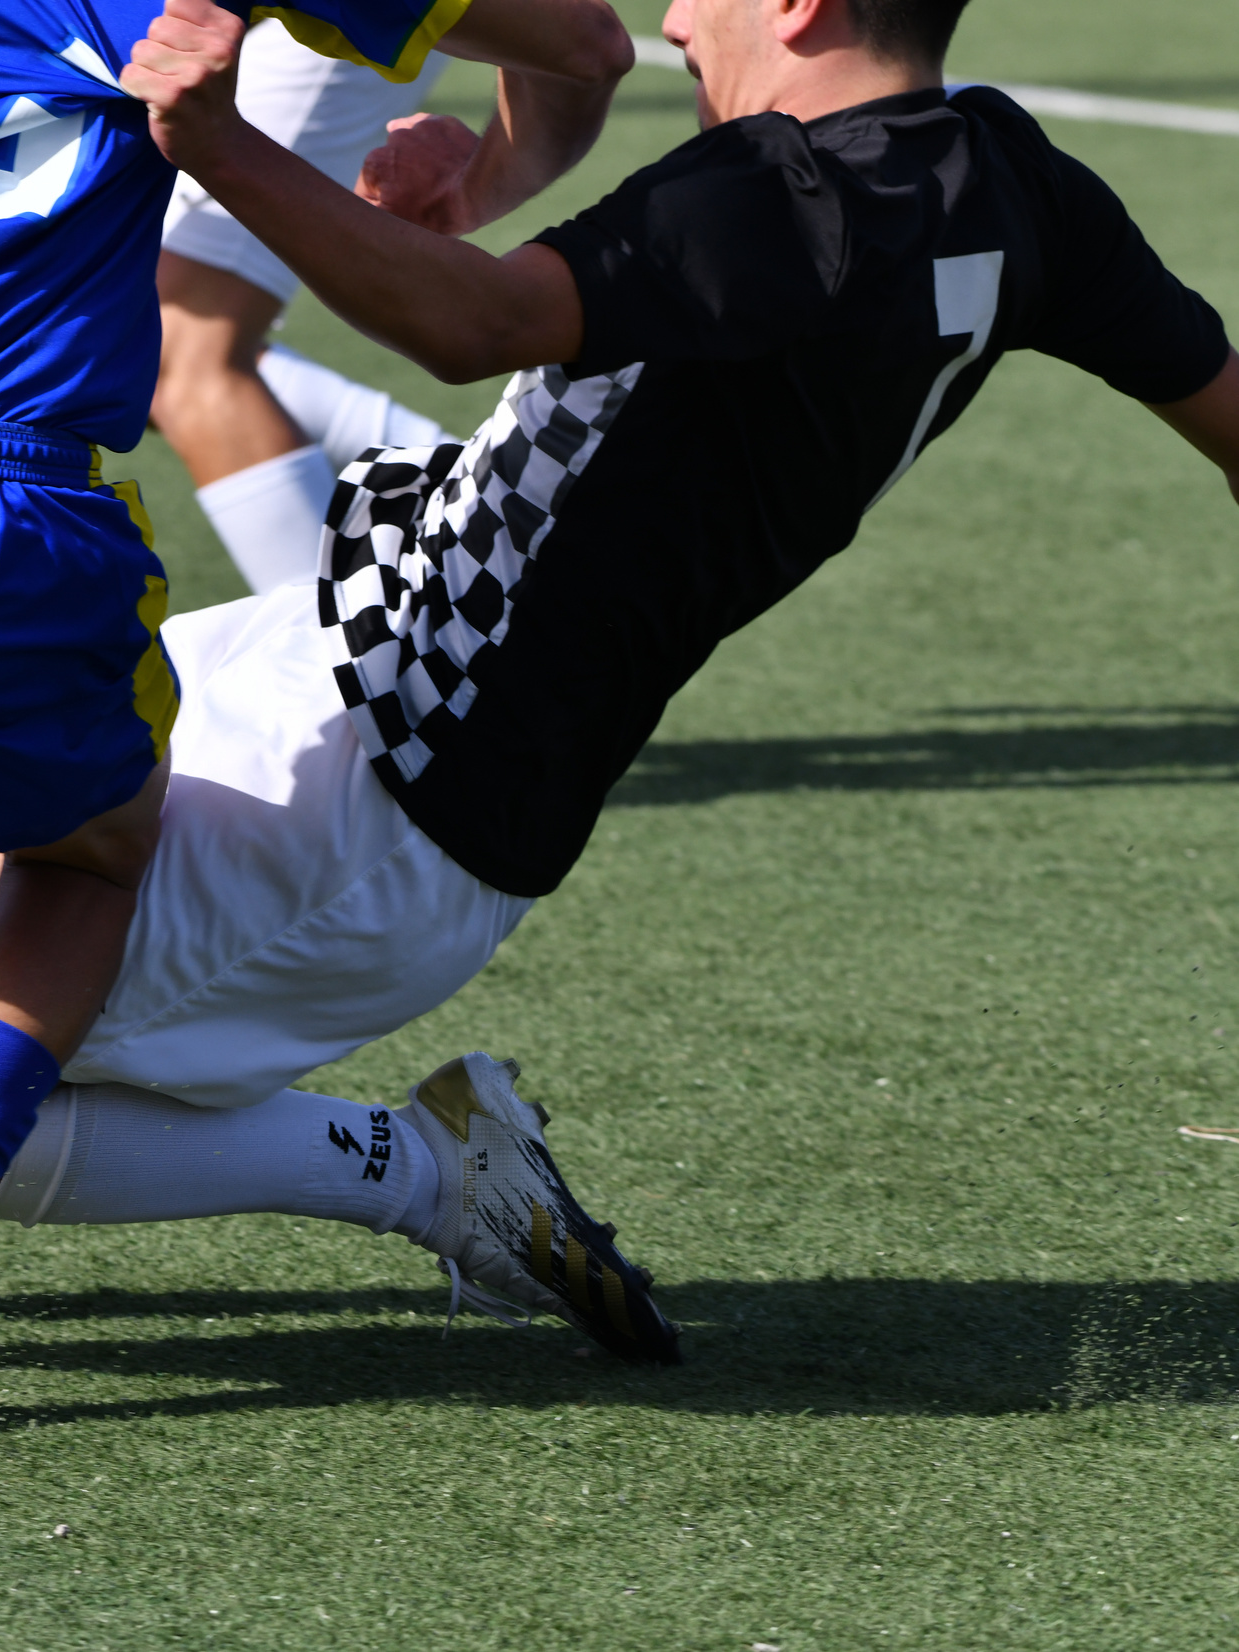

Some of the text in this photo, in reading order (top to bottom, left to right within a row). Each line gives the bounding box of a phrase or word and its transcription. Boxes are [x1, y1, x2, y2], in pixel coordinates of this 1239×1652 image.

[362, 1109, 392, 1183] ZEUS
[477, 1148, 489, 1172] R.S.
[463, 1156, 477, 1213] PREDATOR
